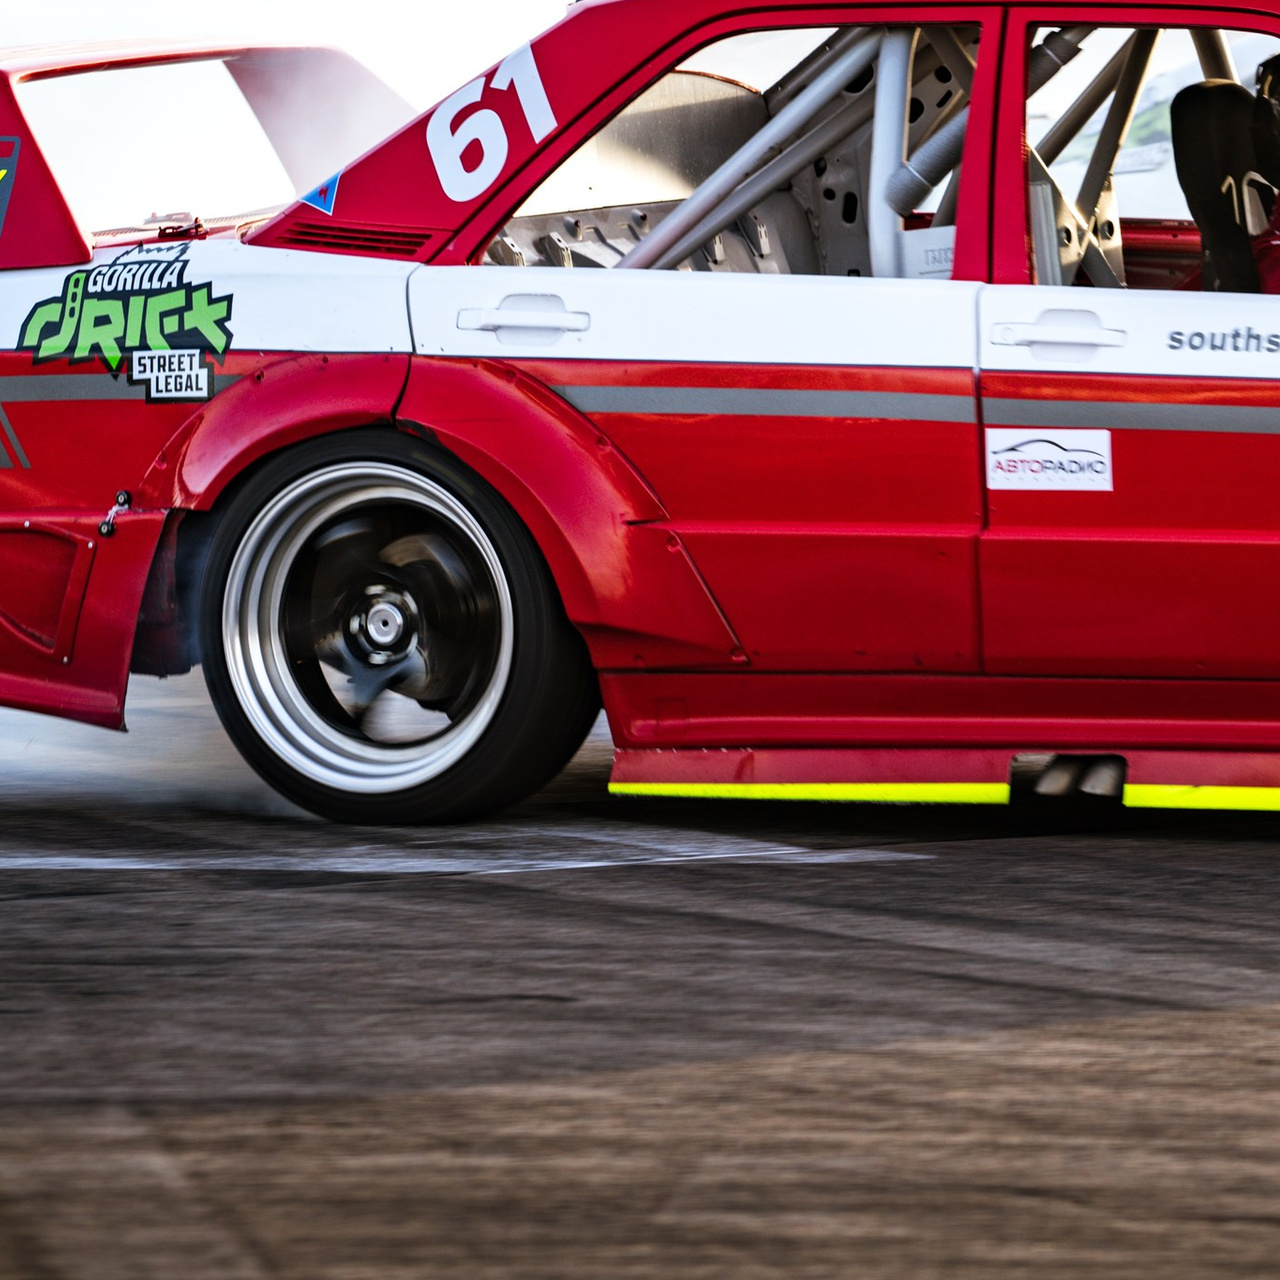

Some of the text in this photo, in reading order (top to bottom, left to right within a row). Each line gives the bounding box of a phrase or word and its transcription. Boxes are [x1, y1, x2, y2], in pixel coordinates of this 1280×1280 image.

[426, 40, 559, 203] 61
[87, 261, 185, 293] GORILLA
[137, 353, 197, 375] STREET
[154, 373, 204, 394] LEGAL
